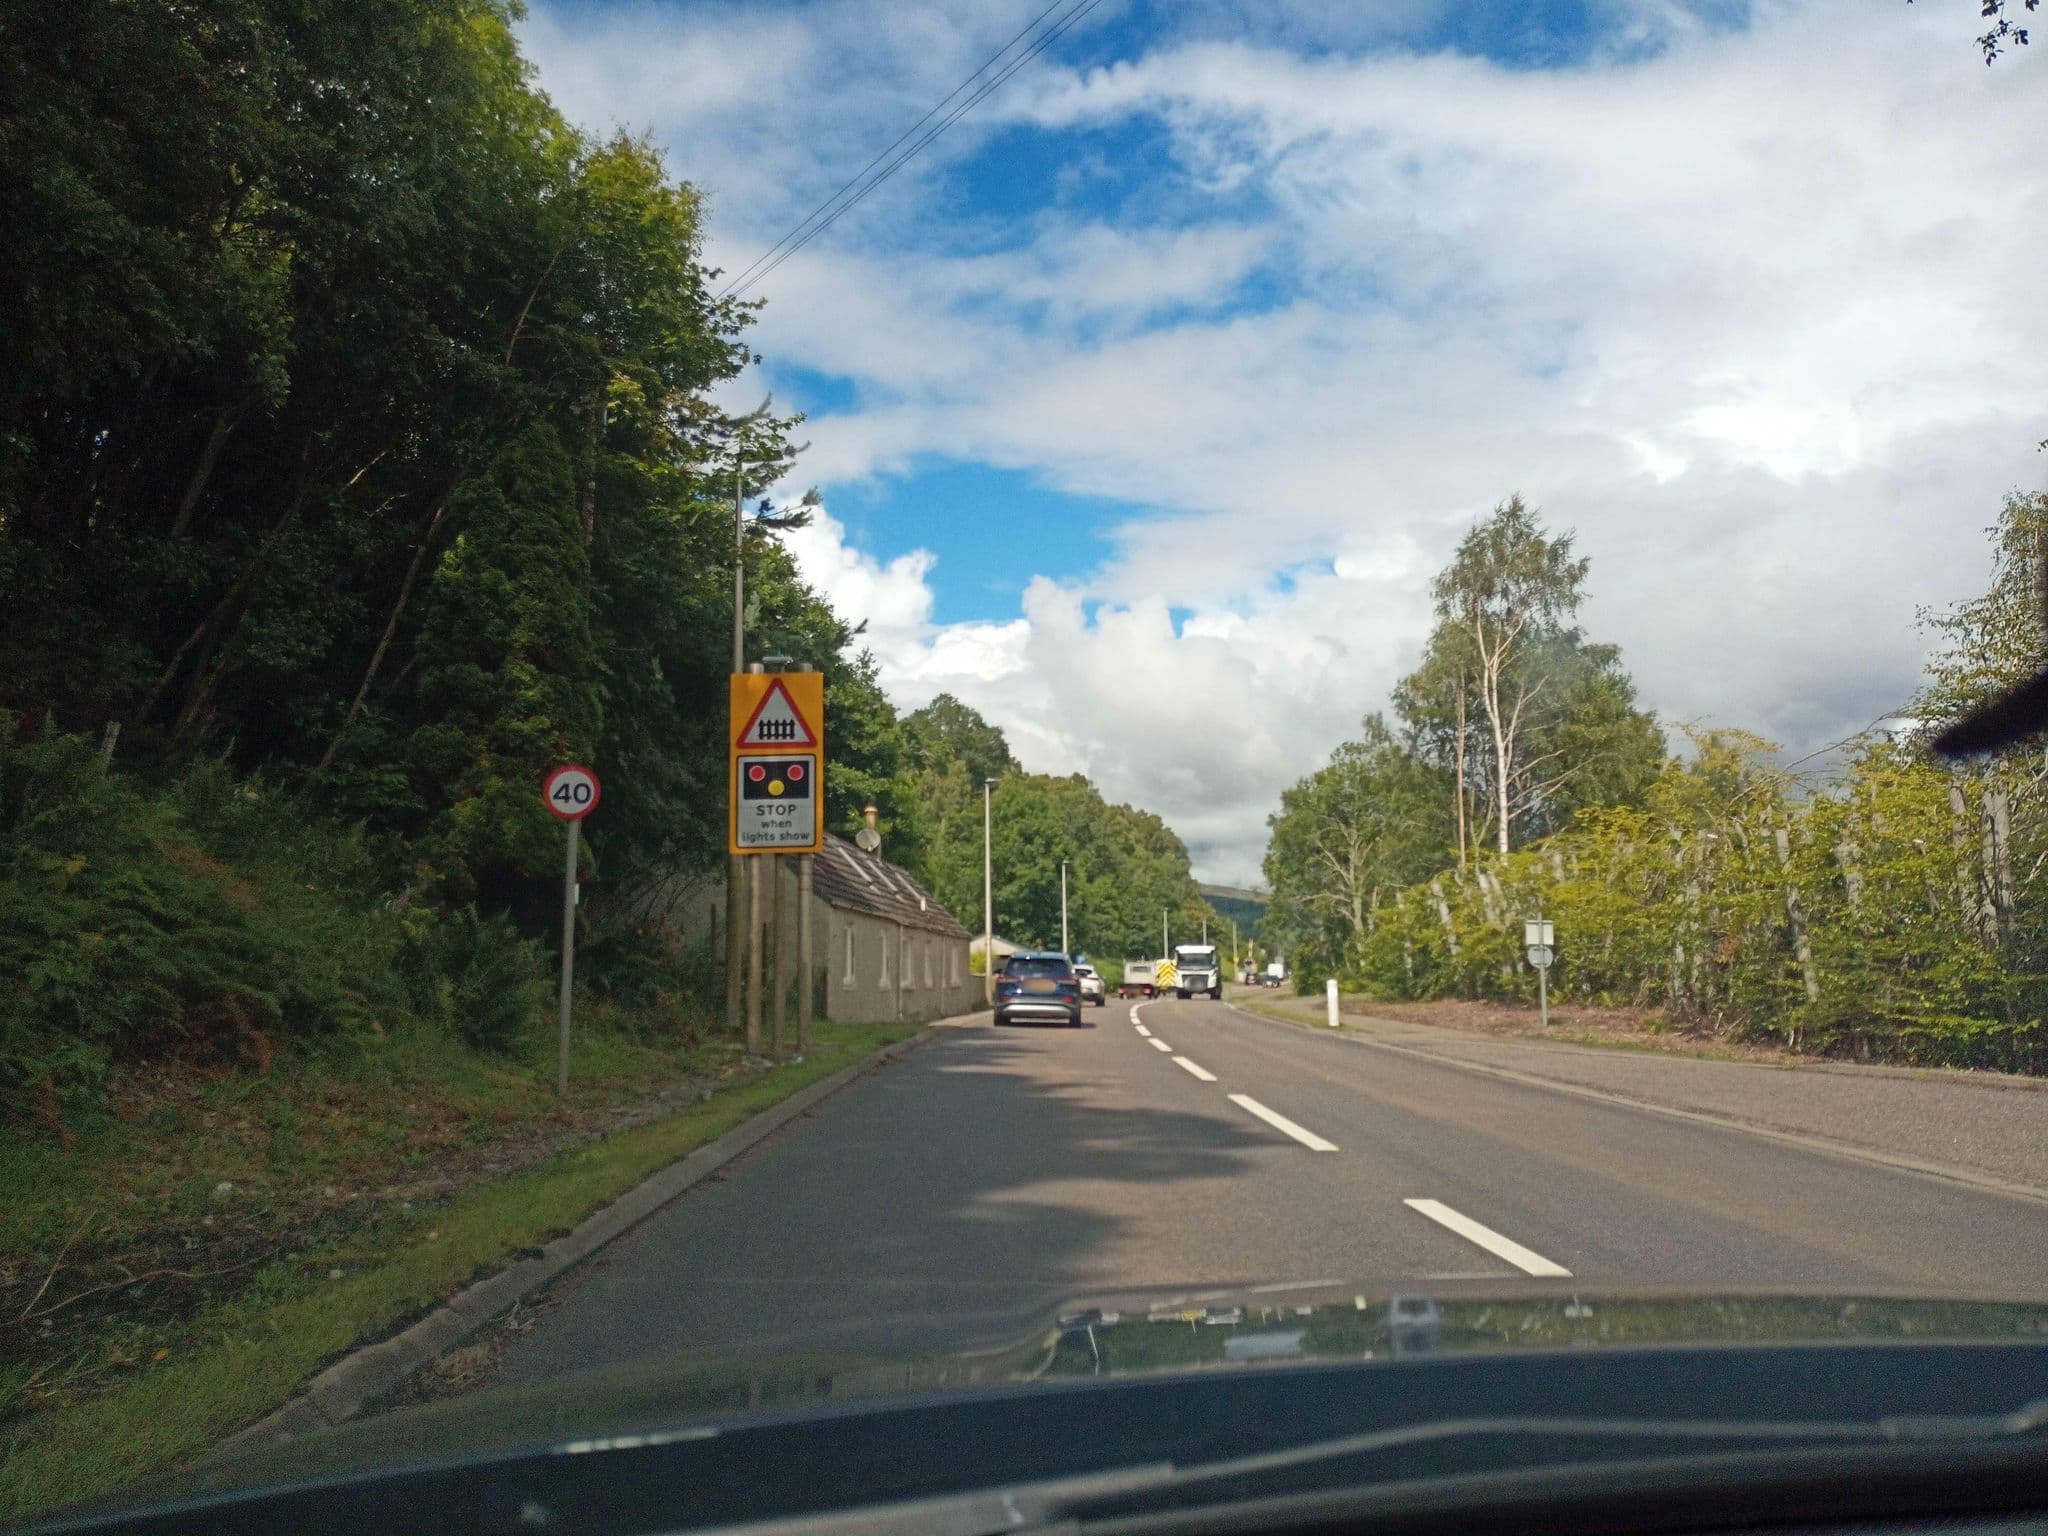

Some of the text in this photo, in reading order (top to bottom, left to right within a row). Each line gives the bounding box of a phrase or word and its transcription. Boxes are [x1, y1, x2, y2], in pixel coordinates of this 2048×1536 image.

[553, 783, 591, 804] 40
[756, 804, 797, 817] STOP
[761, 819, 792, 828] when
[742, 831, 810, 843] lights show
